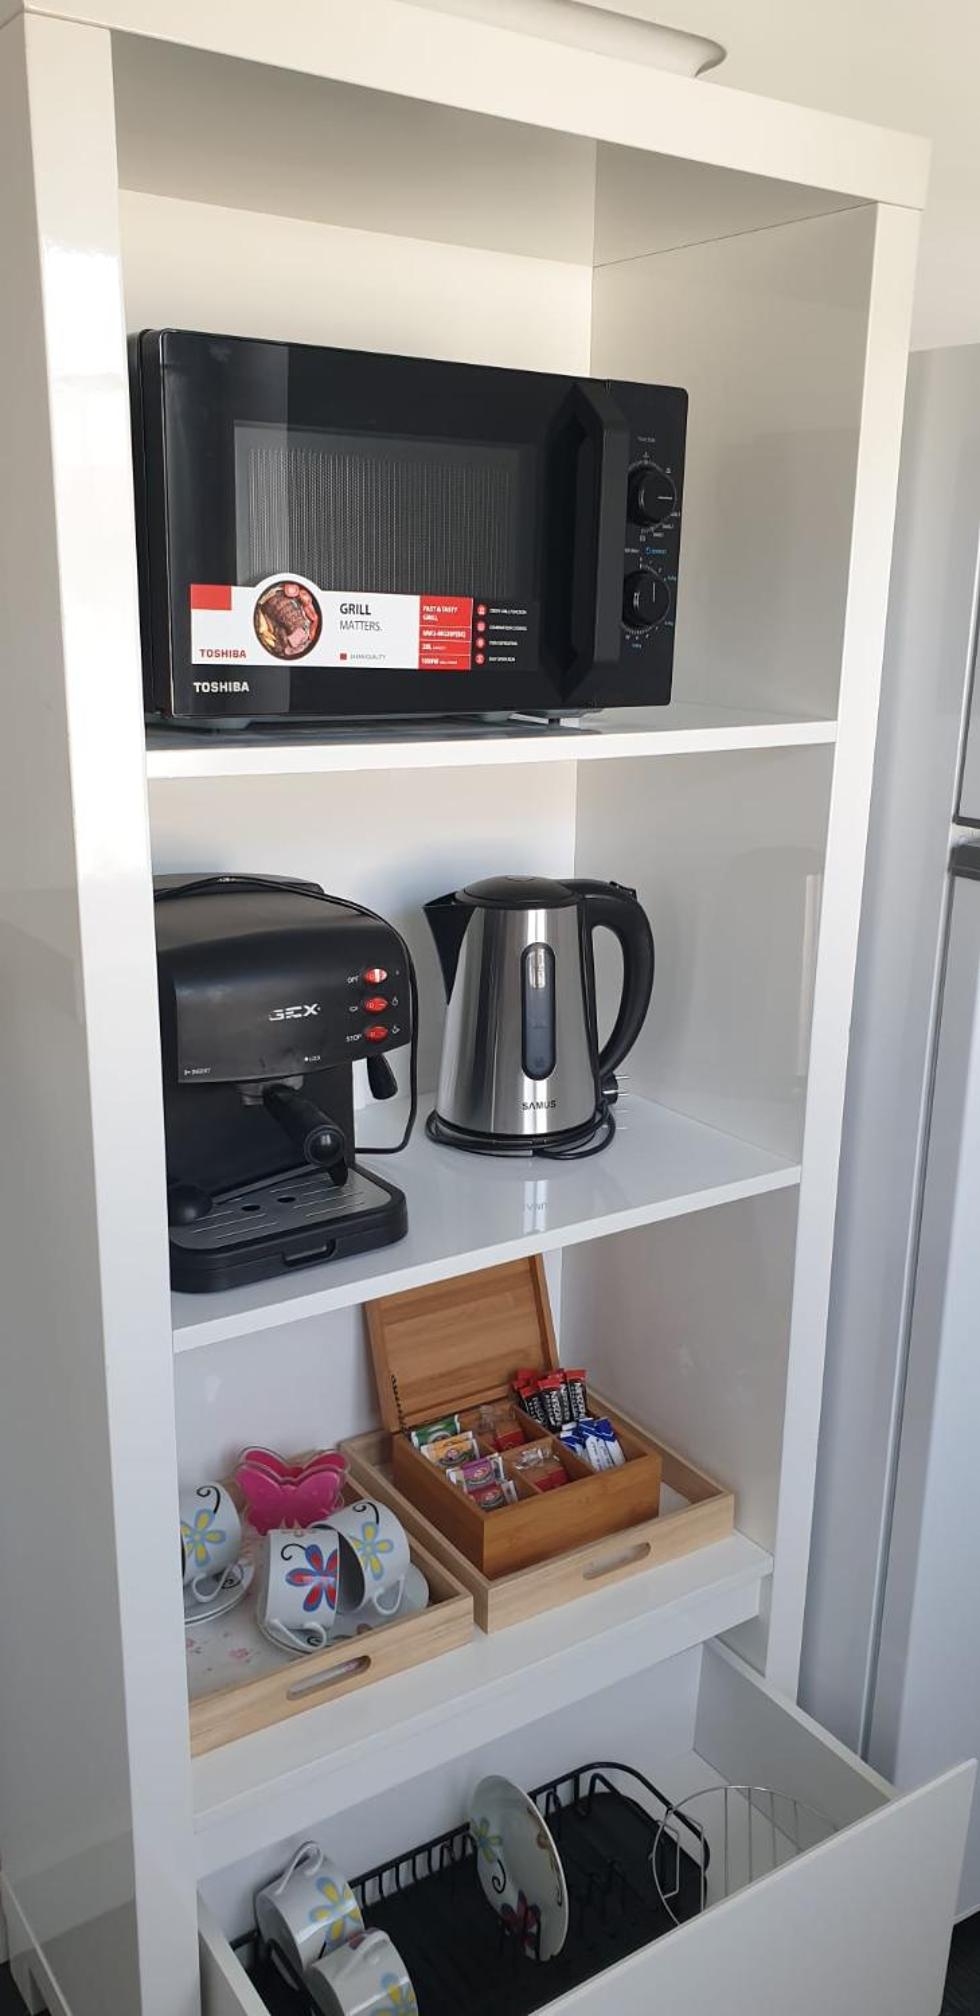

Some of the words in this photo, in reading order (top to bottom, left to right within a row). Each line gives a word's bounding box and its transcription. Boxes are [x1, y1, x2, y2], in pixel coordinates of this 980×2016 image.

[340, 603, 371, 615] GRILL
[340, 620, 383, 631] MATTERS.
[199, 648, 247, 659] TOSHIBA
[193, 681, 250, 693] TOSHIBA
[522, 1100, 557, 1111] SAMUS
